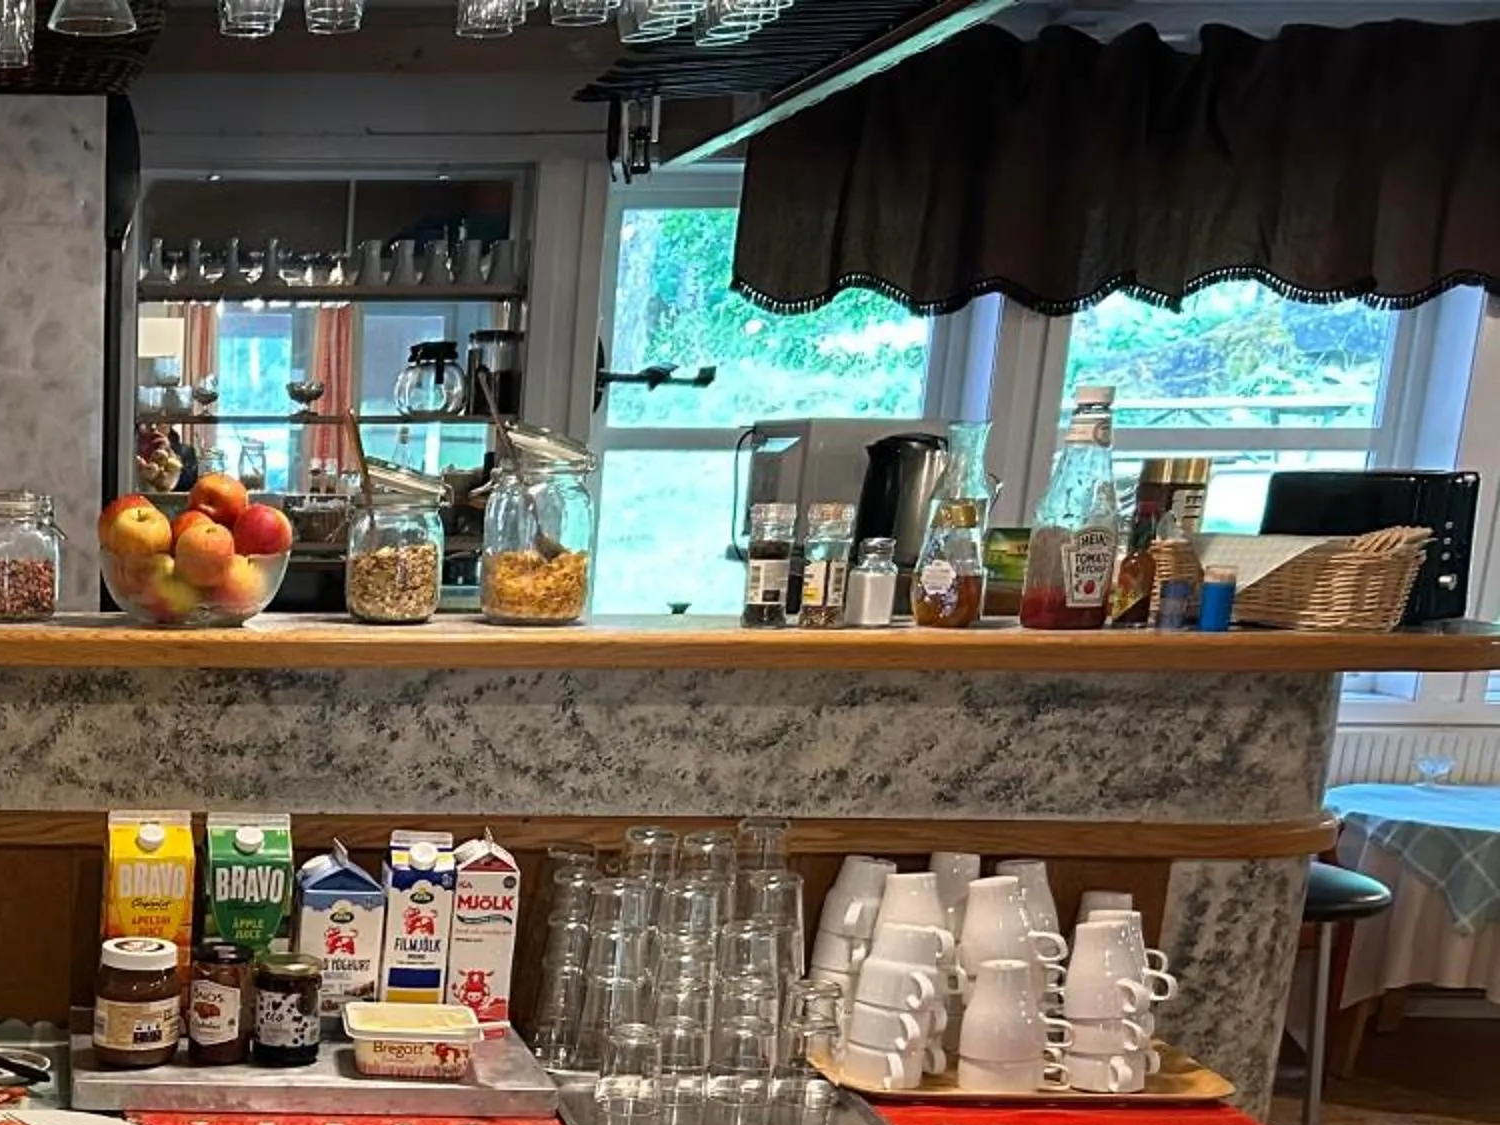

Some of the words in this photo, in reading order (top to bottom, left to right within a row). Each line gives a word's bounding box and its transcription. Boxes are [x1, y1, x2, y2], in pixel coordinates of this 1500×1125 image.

[119, 862, 186, 898] BRAVO
[215, 864, 285, 903] BRAVO
[457, 895, 514, 911] MJÖLK
